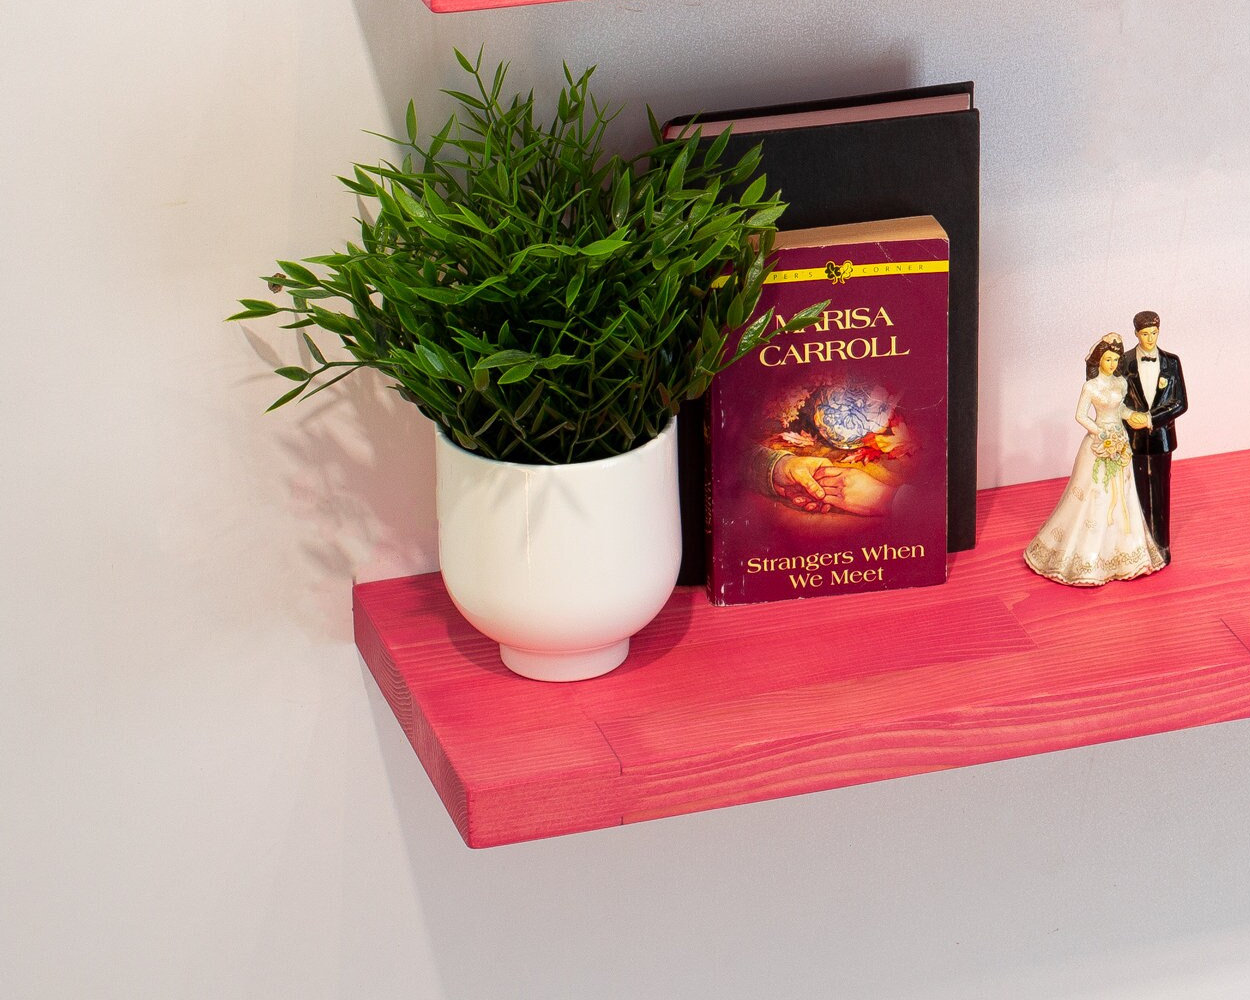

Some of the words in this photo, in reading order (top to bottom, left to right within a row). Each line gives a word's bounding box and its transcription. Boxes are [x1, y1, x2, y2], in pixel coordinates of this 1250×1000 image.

[862, 264, 924, 274] CORNER
[759, 335, 911, 367] CARROLL
[746, 550, 854, 574] Strangers
[861, 544, 925, 563] When
[788, 573, 824, 589] We
[830, 566, 885, 586] Meet
